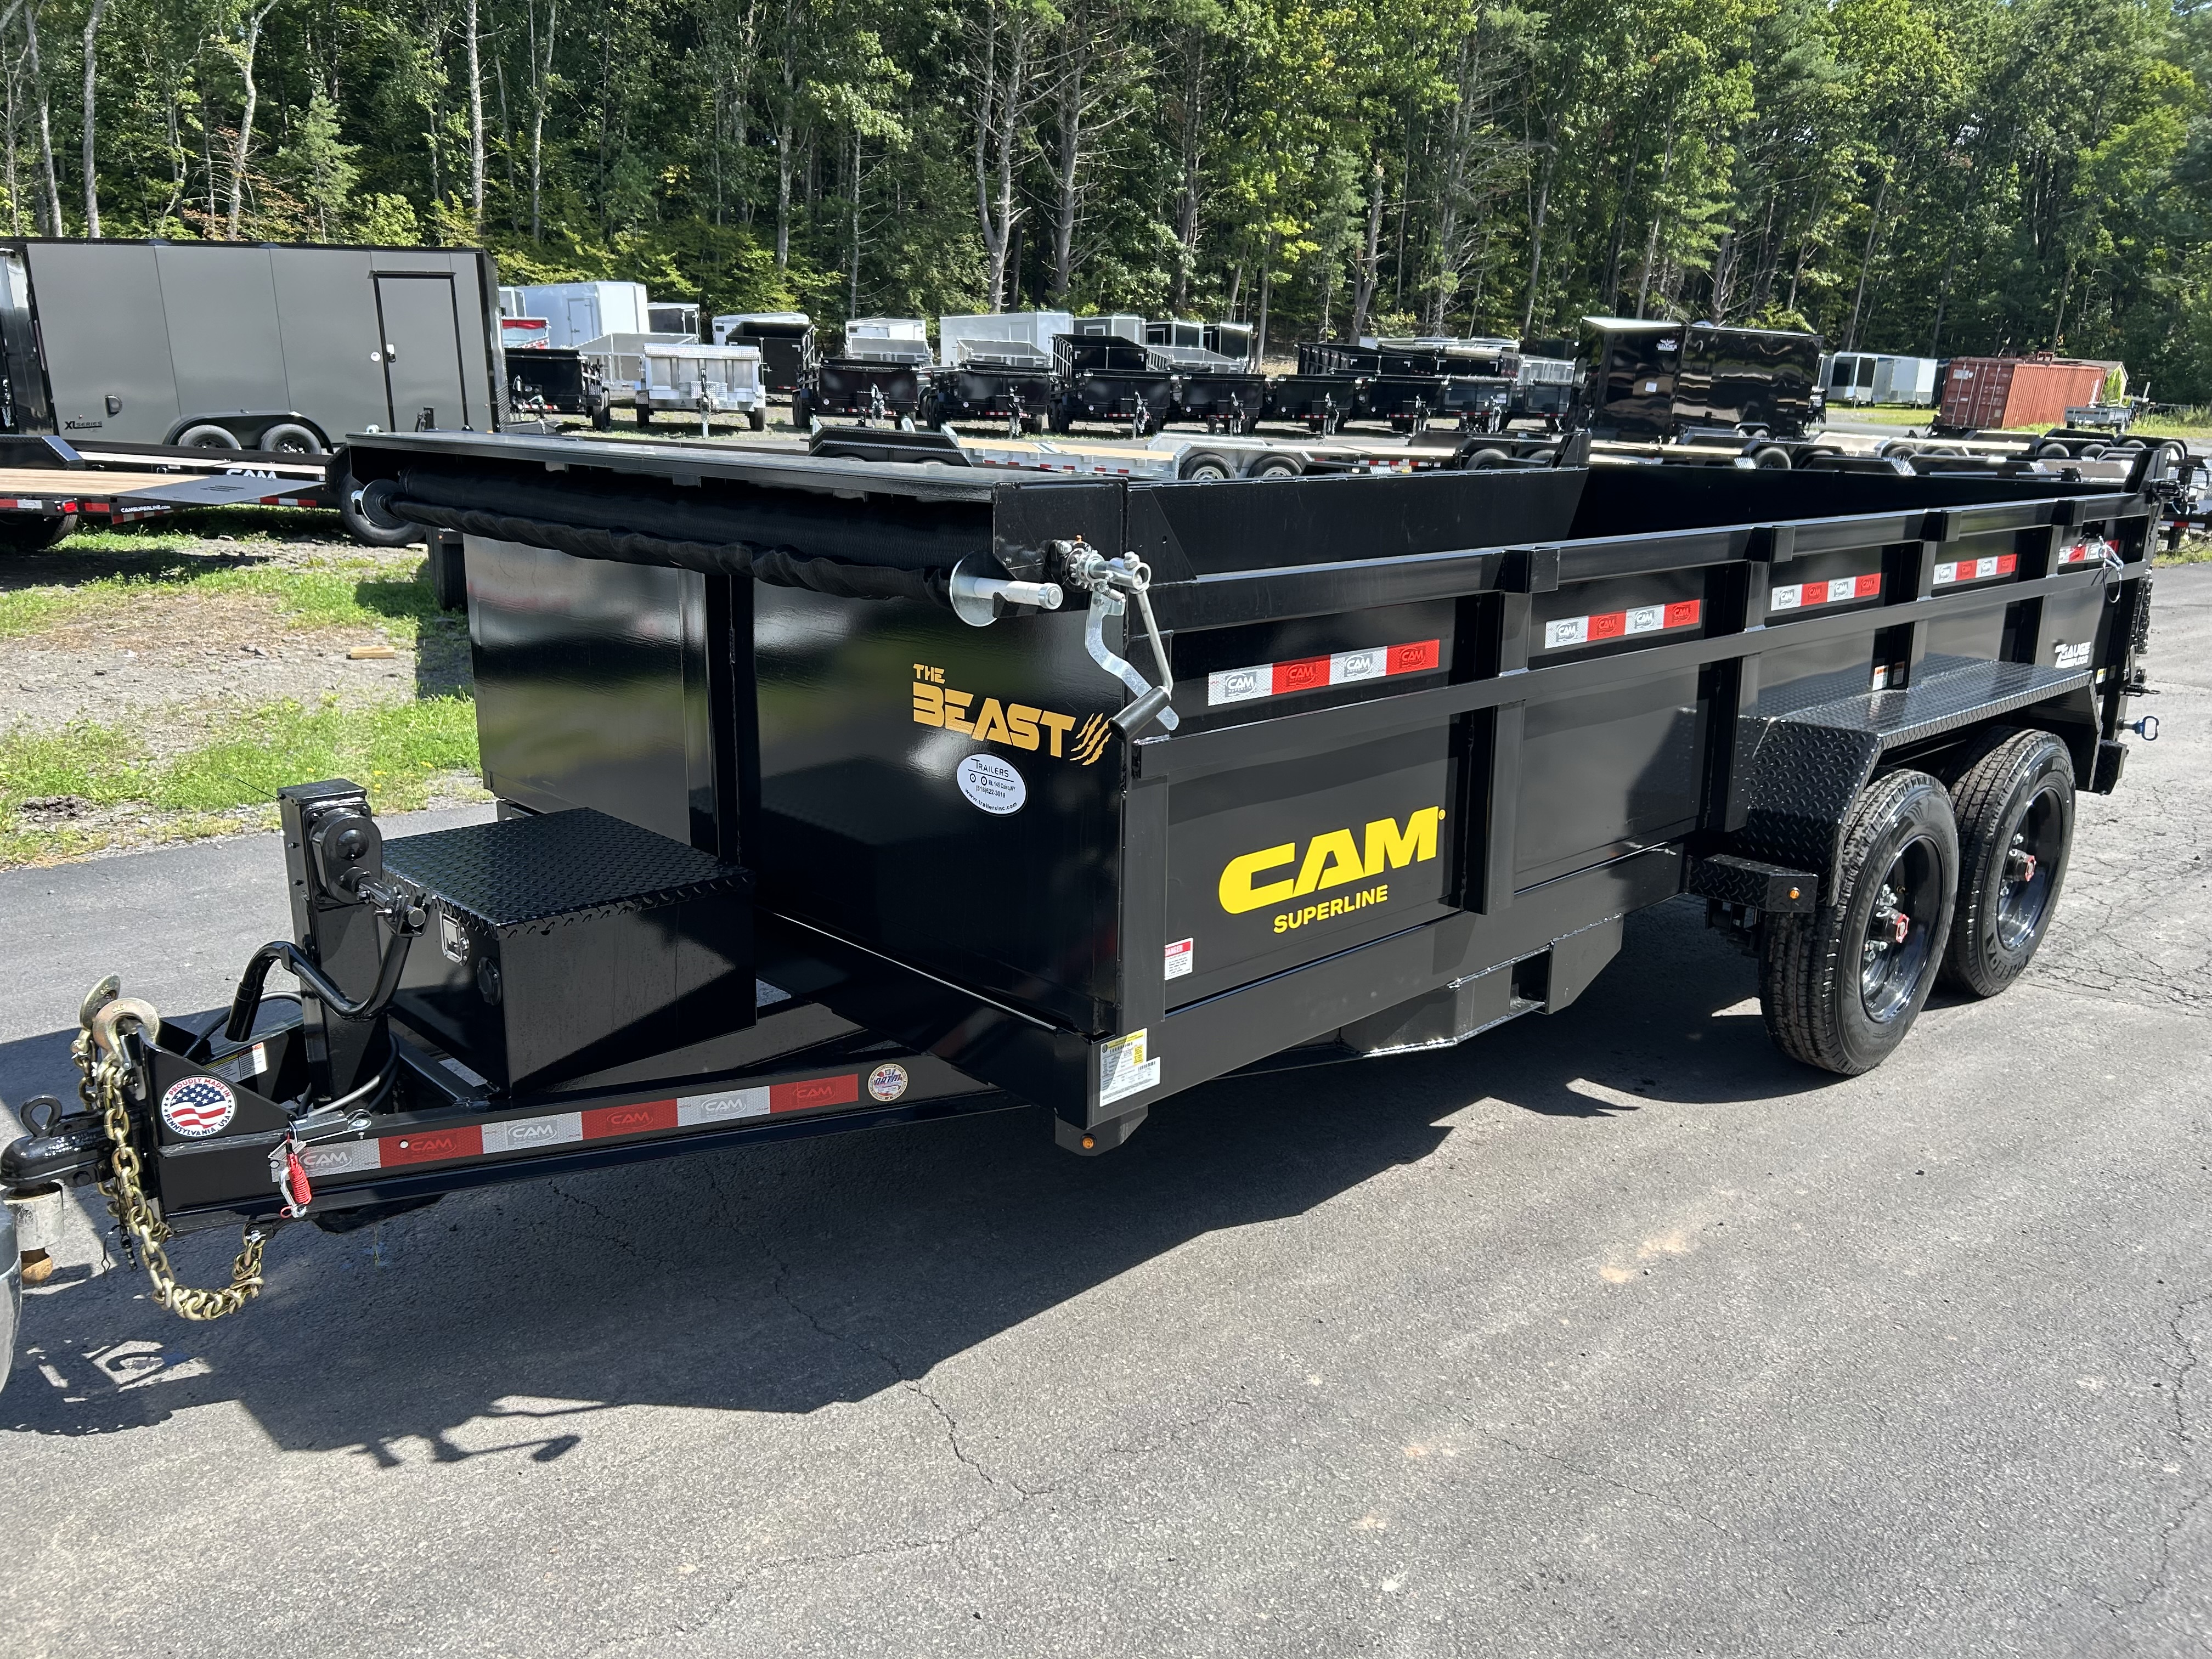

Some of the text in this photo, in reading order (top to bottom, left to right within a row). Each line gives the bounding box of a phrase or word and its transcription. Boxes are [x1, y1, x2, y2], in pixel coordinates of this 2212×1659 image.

[1636, 611, 1653, 623] CAM
[1674, 606, 1689, 618] CAM
[1598, 618, 1616, 629] CAM
[1558, 625, 1576, 636] CAM
[1402, 649, 1424, 662] CAM
[1347, 658, 1370, 670] CAM
[913, 663, 946, 684] THE
[1289, 666, 1313, 679] CAM
[1228, 676, 1255, 690] CAM
[913, 682, 1076, 758] BEAST
[965, 788, 1018, 811] www.trailersinc.com
[1219, 806, 1439, 915] CAM
[1273, 884, 1389, 934] SUPERLINE
[168, 1078, 202, 1096] PROUDLY
[204, 1079, 226, 1091] MADE
[797, 1086, 833, 1098] CAM
[705, 1098, 743, 1111] CAM
[218, 1115, 231, 1127] USA
[611, 1111, 650, 1125] CAM
[512, 1124, 554, 1138] CAM
[410, 1138, 453, 1152] CAM
[303, 1152, 348, 1165] CAM
